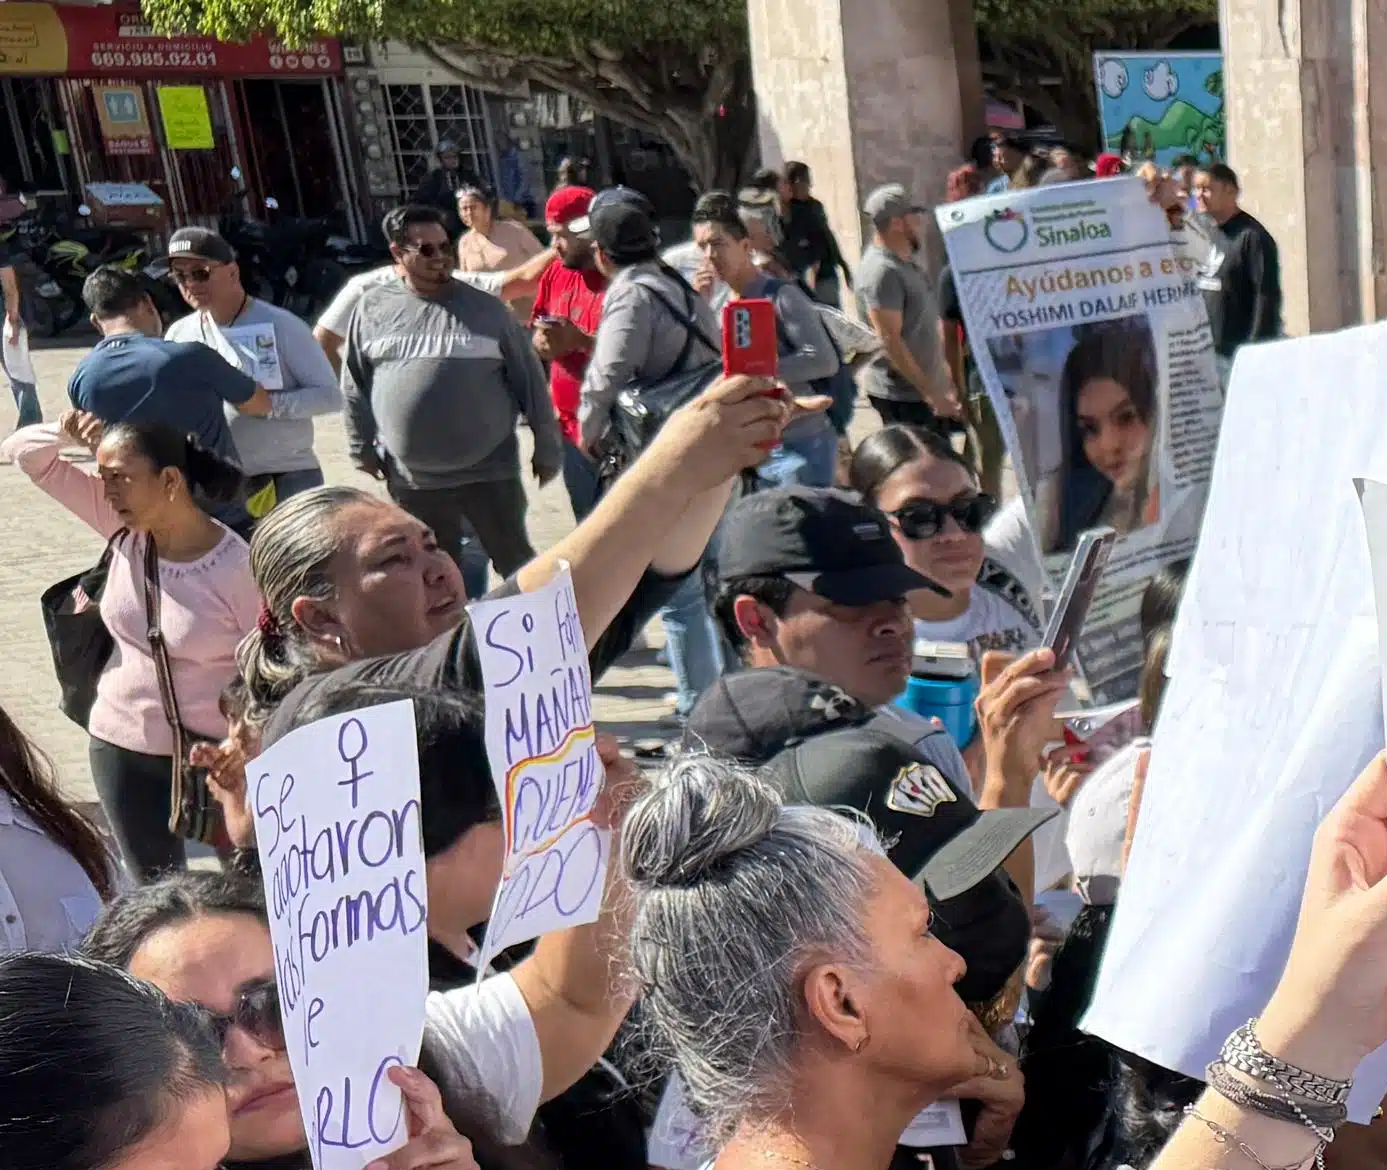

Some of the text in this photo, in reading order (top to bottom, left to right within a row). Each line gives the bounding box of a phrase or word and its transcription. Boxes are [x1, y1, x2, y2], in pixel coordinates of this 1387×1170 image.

[91, 52, 217, 67] 669.985.02.01
[1034, 221, 1112, 248] Sinaloa
[1006, 261, 1133, 303] Ayúdanos
[1139, 260, 1153, 278] a
[989, 303, 1075, 331] YOSHIMI
[485, 609, 535, 688] Si
[255, 772, 295, 857] Se
[492, 827, 601, 946] ODO
